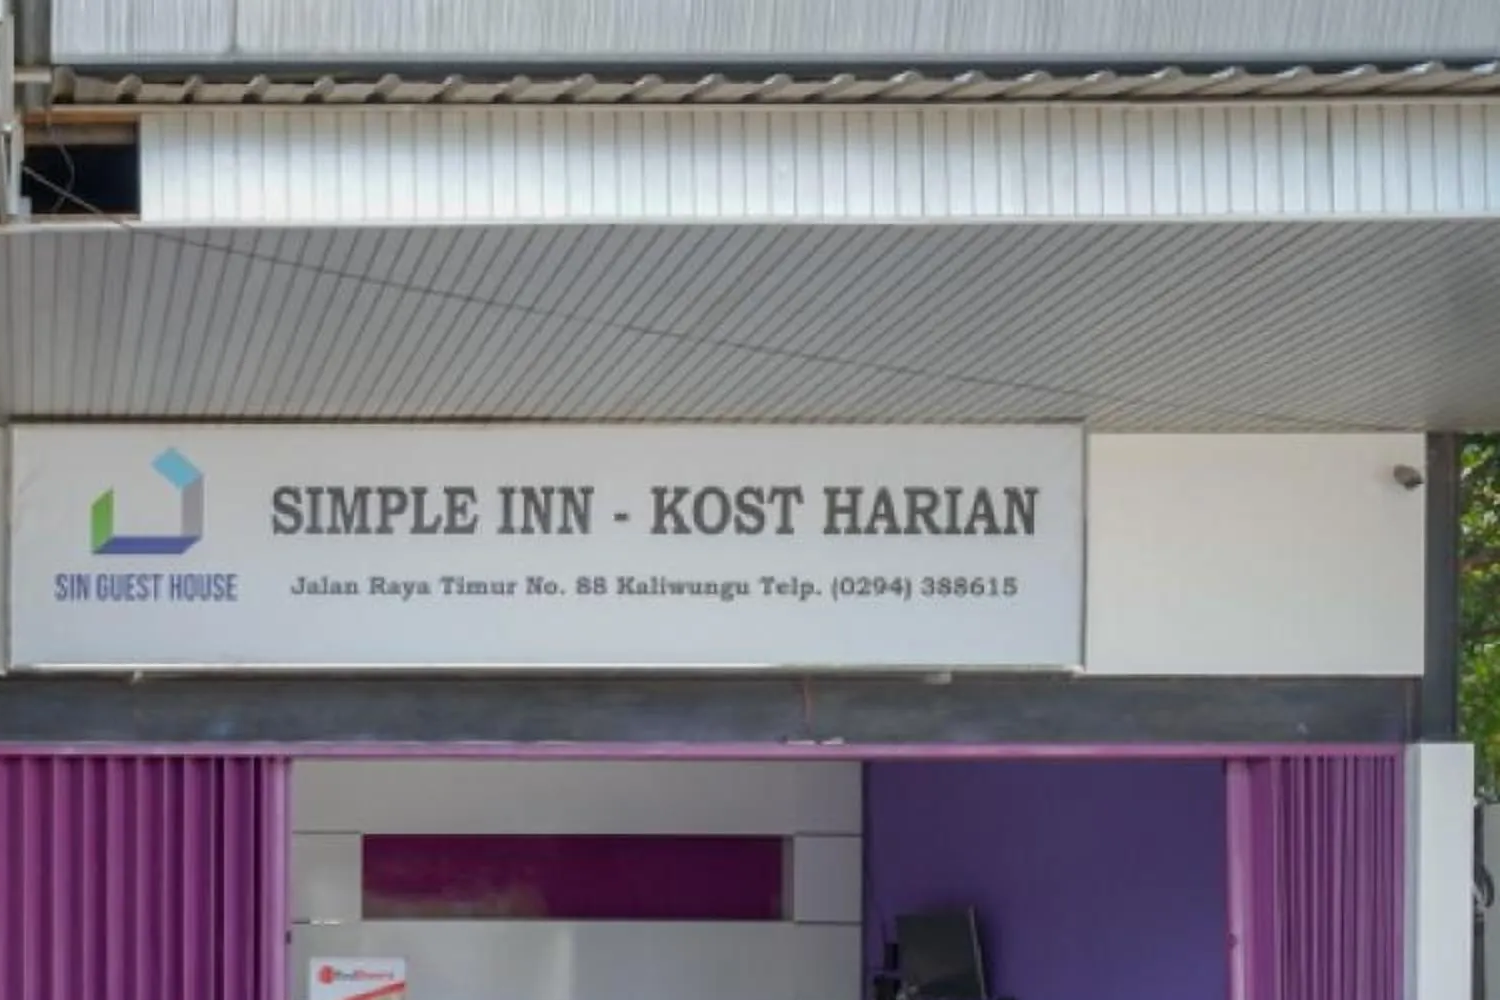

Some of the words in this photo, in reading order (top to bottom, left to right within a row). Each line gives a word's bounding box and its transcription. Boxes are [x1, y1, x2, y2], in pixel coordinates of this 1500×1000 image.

[271, 485, 480, 536] SIMPLE
[496, 485, 595, 536] INN
[649, 484, 805, 536] KOST
[822, 485, 1041, 537] HARIAN
[54, 572, 89, 602] SIN
[96, 572, 163, 602] GUEST
[170, 572, 238, 602] HOUSE
[290, 575, 360, 597] Jalan
[368, 575, 432, 602] Raya
[438, 575, 518, 597] Timur
[525, 575, 566, 597] No.
[575, 575, 608, 597] 88
[615, 575, 751, 603] Kaliwungu
[758, 575, 823, 603] Telp.
[830, 575, 913, 602] (0294)
[920, 575, 1019, 598] 388615
